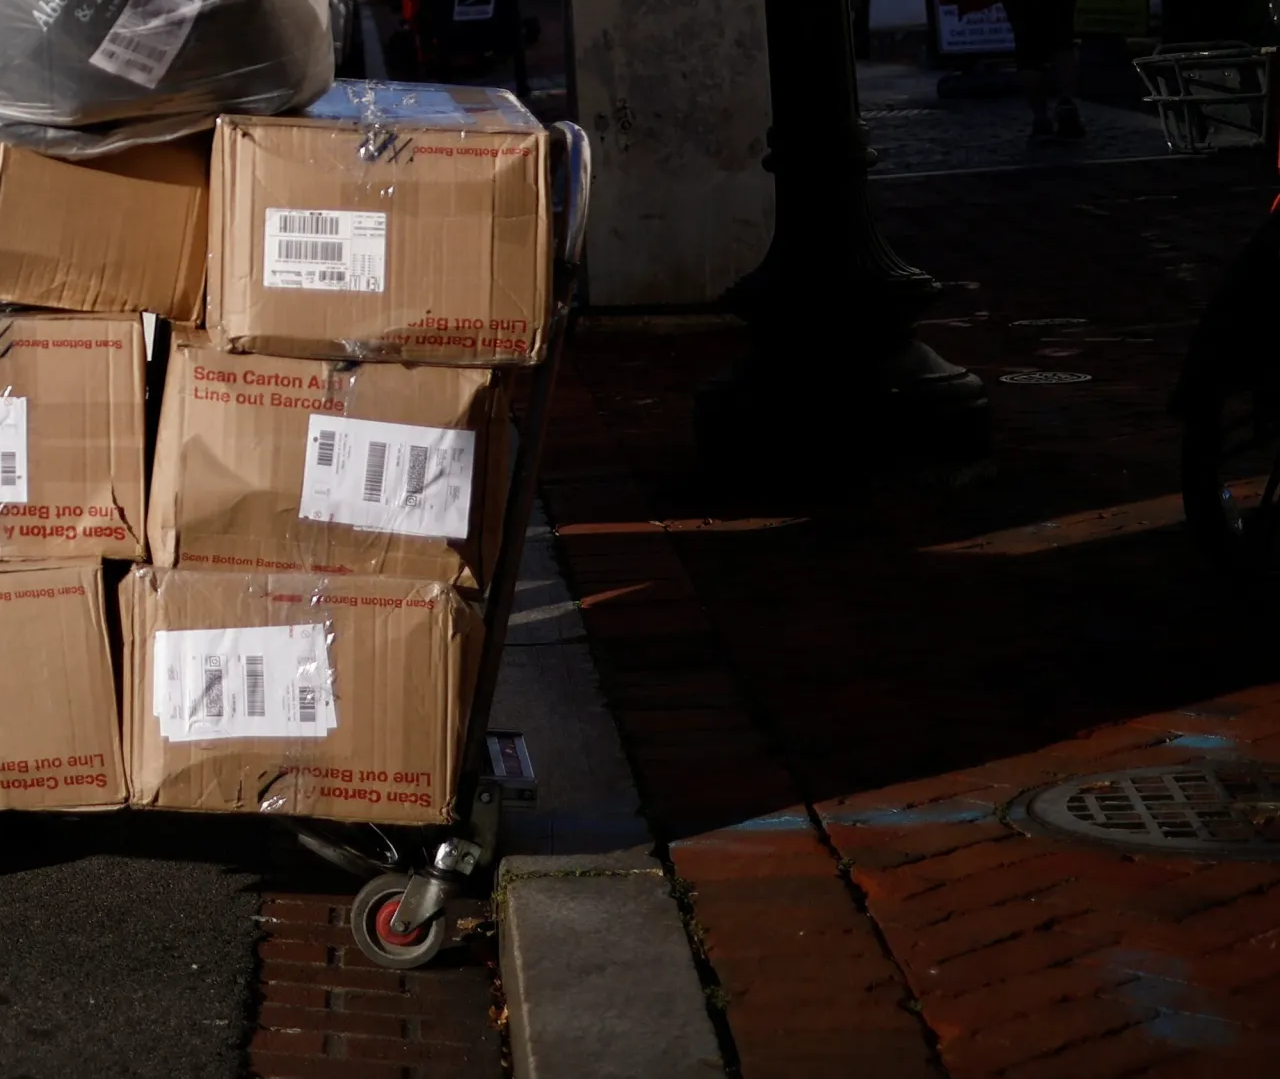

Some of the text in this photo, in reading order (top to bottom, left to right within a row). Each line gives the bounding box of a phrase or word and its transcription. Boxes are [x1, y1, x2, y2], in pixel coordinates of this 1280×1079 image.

[75, 3, 93, 21] &
[412, 145, 529, 157] Scan Bottom Barcod
[454, 318, 483, 330] out
[489, 319, 526, 332] Line
[52, 340, 92, 348] Bottom
[95, 340, 122, 348] Scan
[415, 335, 475, 348] Carton
[481, 337, 526, 352] Scan
[193, 366, 236, 382] Scan
[242, 370, 302, 387] Carton
[193, 387, 344, 410] Line out Barcode
[55, 505, 83, 518] out
[19, 525, 76, 539] Carton
[83, 526, 125, 539] Scan
[181, 552, 208, 562] Scan
[212, 554, 252, 565] Bottom
[14, 588, 54, 599] Bottom
[58, 585, 84, 595] Scan
[361, 596, 402, 609] Bottom
[405, 598, 434, 609] Scan
[34, 757, 61, 770] out
[67, 753, 104, 767] Line
[63, 773, 106, 788] Scan
[358, 770, 387, 782] out
[393, 772, 430, 786] Line
[0, 776, 58, 790] Carton
[320, 786, 380, 803] Carton
[386, 791, 431, 807] Scan
